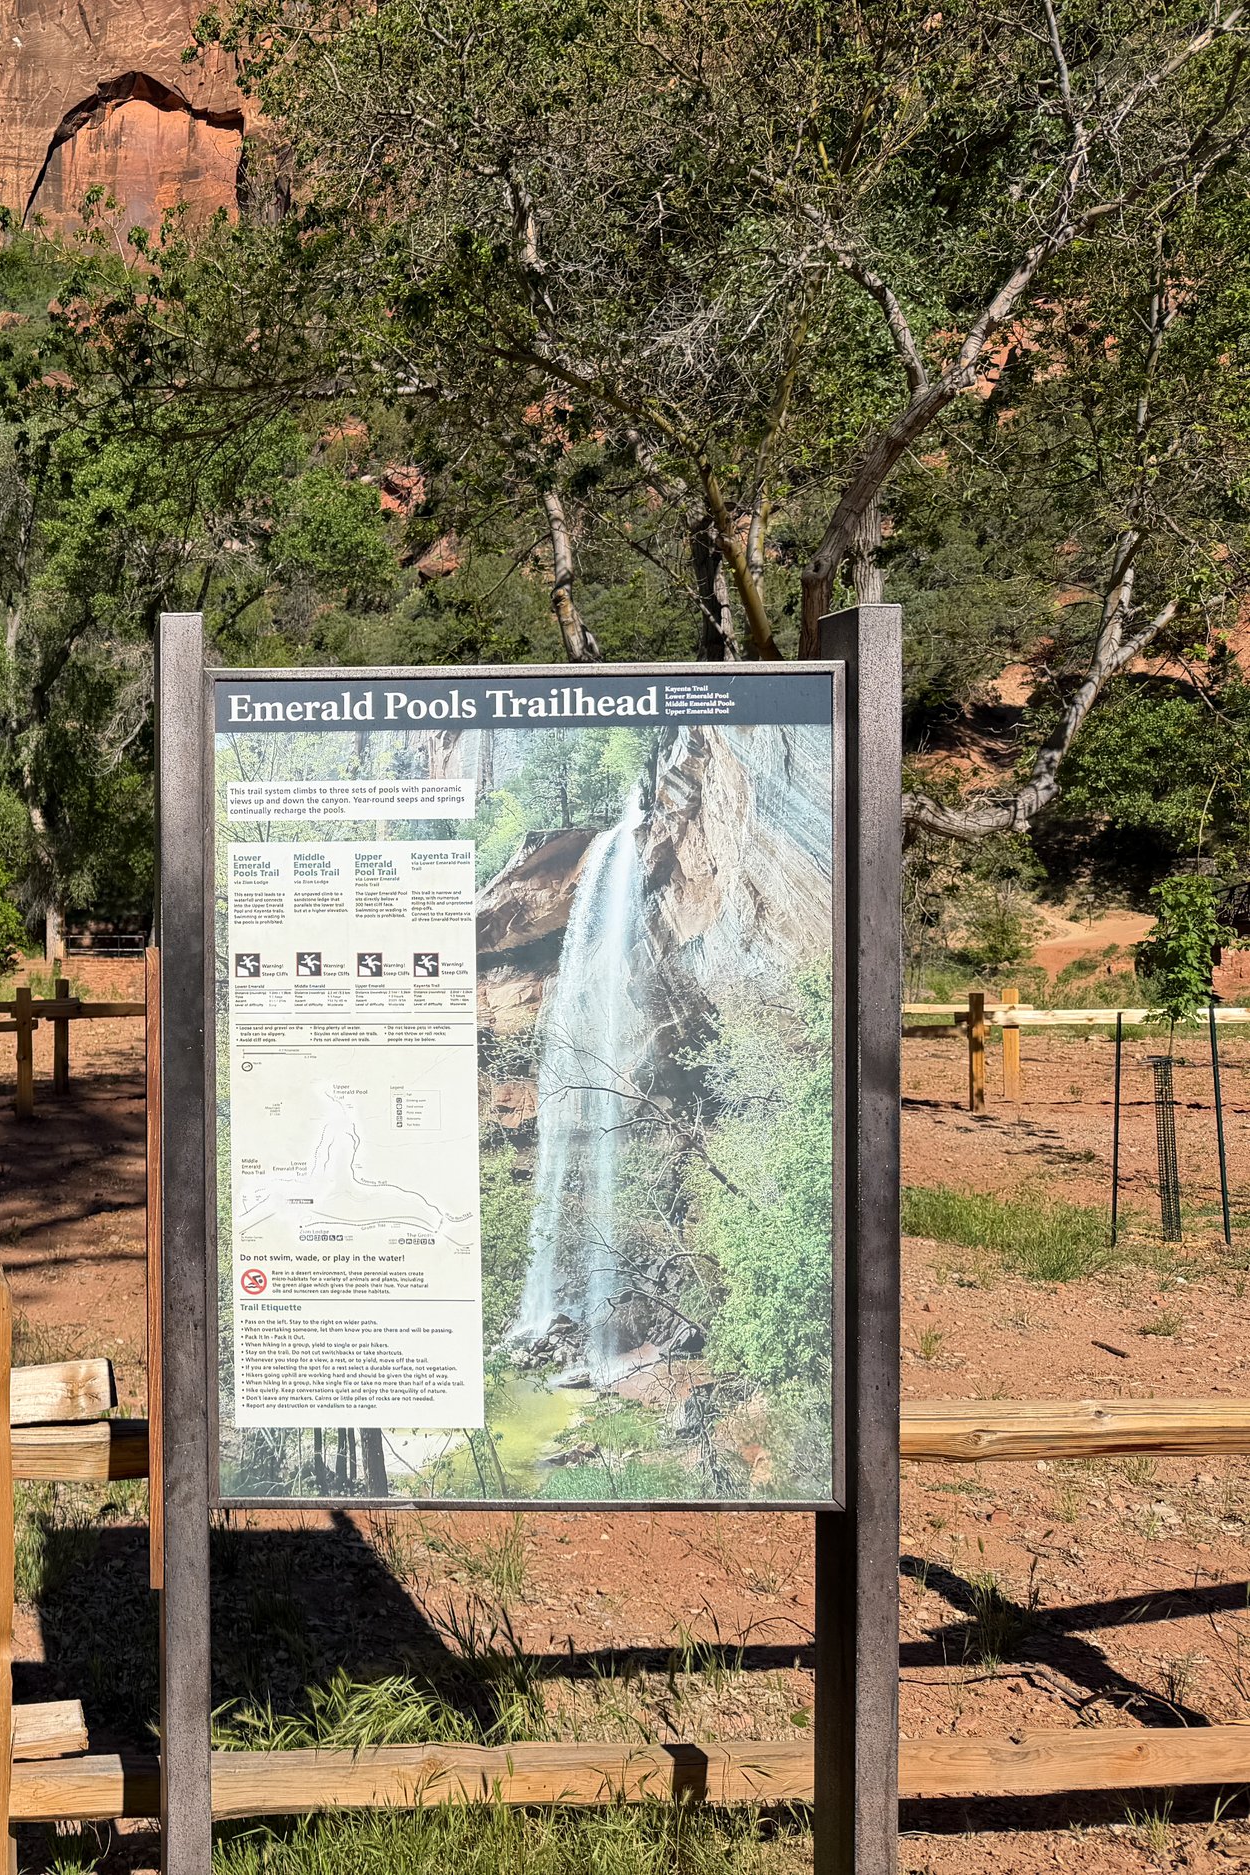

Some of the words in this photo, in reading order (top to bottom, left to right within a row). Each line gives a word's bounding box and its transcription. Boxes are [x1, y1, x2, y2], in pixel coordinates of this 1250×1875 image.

[665, 685, 692, 694] Kayenta
[228, 691, 375, 723] Emerald
[384, 689, 477, 720] Pools
[485, 686, 659, 718] Trailhead
[665, 708, 686, 716] Upper
[247, 787, 263, 795] trail
[264, 788, 291, 796] system
[292, 787, 317, 795] climbs
[329, 786, 349, 794] three
[378, 786, 399, 795] pools
[421, 785, 461, 794] panoramic
[229, 797, 252, 805] views
[266, 797, 280, 805] and
[321, 797, 350, 806] canyon.
[353, 796, 395, 804] Year-round
[420, 795, 435, 803] and
[437, 795, 465, 804] springs
[229, 807, 272, 816] continually
[273, 807, 306, 816] recharge
[308, 806, 321, 814] the
[323, 806, 345, 815] pools.
[233, 854, 262, 862] Lower
[293, 853, 325, 861] Middle
[355, 853, 383, 862] Upper
[410, 852, 449, 862] Kayenta
[451, 852, 471, 862] Trail
[233, 861, 271, 870] Emerald
[293, 861, 331, 870] Emerald
[233, 869, 258, 877] Pools
[260, 869, 279, 877] Trail
[293, 869, 318, 877] Pools
[377, 868, 397, 876] Trail
[269, 1254, 293, 1262] swim,
[295, 1254, 320, 1262] wade,
[333, 1254, 350, 1263] play
[362, 1254, 376, 1262] the
[378, 1254, 405, 1262] water!
[240, 1303, 259, 1311] Trail
[261, 1304, 302, 1313] Etiquette
